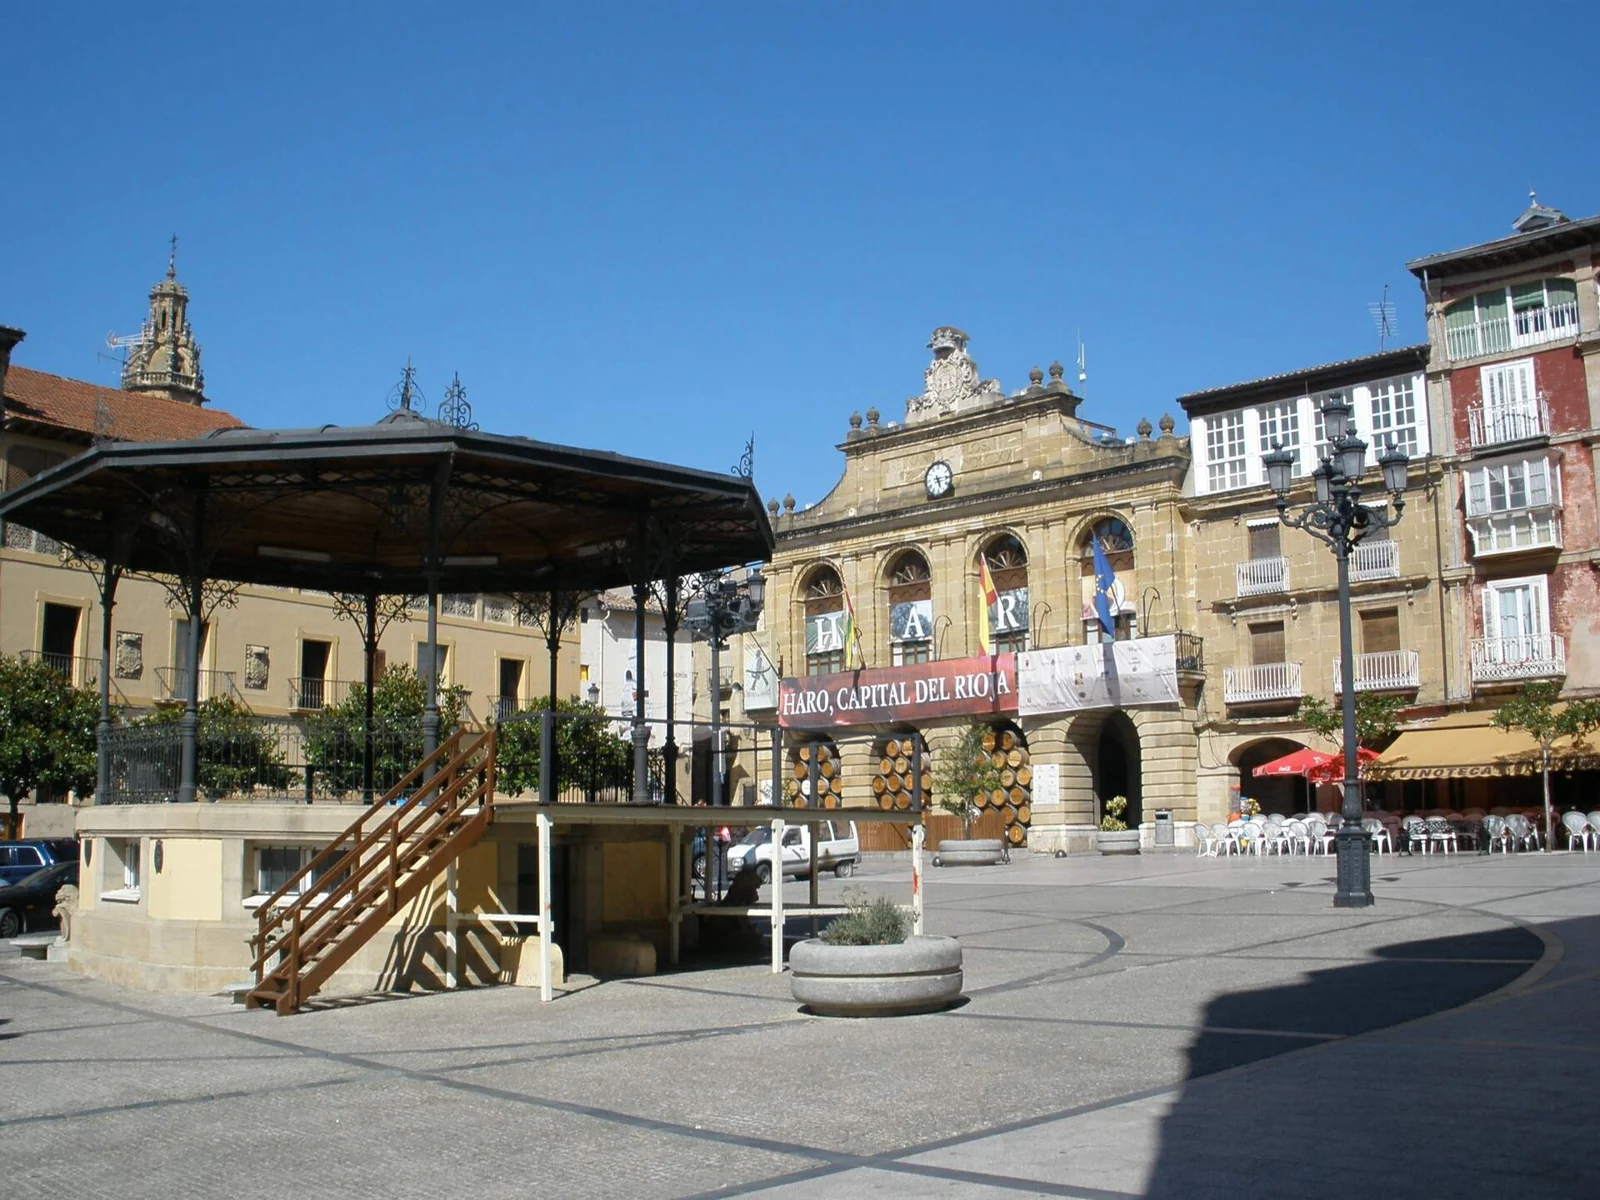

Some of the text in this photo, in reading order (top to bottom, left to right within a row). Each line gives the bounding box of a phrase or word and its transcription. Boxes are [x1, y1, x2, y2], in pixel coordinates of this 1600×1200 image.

[815, 617, 841, 650] H
[902, 606, 925, 638] A
[783, 669, 1011, 716] HARO, CAPITAL DEL RIOJA
[1399, 766, 1492, 778] VINOTECA
